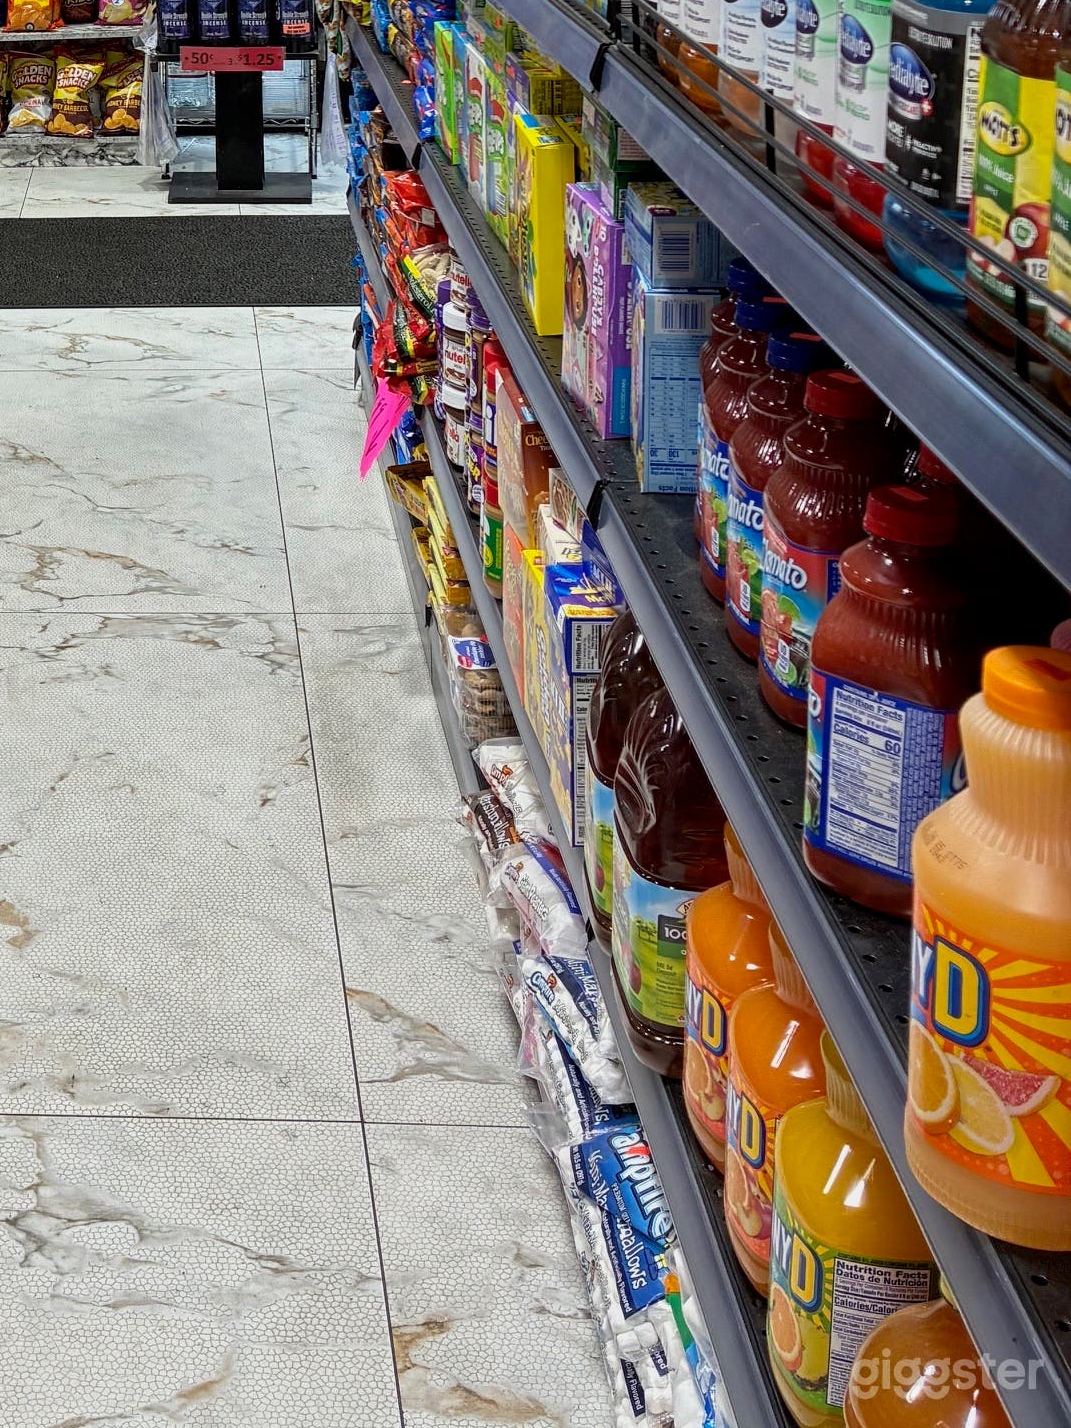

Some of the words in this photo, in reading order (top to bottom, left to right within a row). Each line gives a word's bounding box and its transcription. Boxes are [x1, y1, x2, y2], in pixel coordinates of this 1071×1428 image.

[237, 53, 275, 66] $1.25
[836, 689, 875, 712] Nutrition
[878, 705, 903, 722] Facts
[833, 723, 870, 745] Calories
[885, 740, 901, 755] 60
[836, 1260, 892, 1278] Nutrition
[895, 1270, 928, 1280] Facts
[836, 1269, 865, 1281] Datos
[867, 1276, 880, 1284] de
[883, 1276, 928, 1287] Nutrición
[617, 1278, 633, 1313] Flavored
